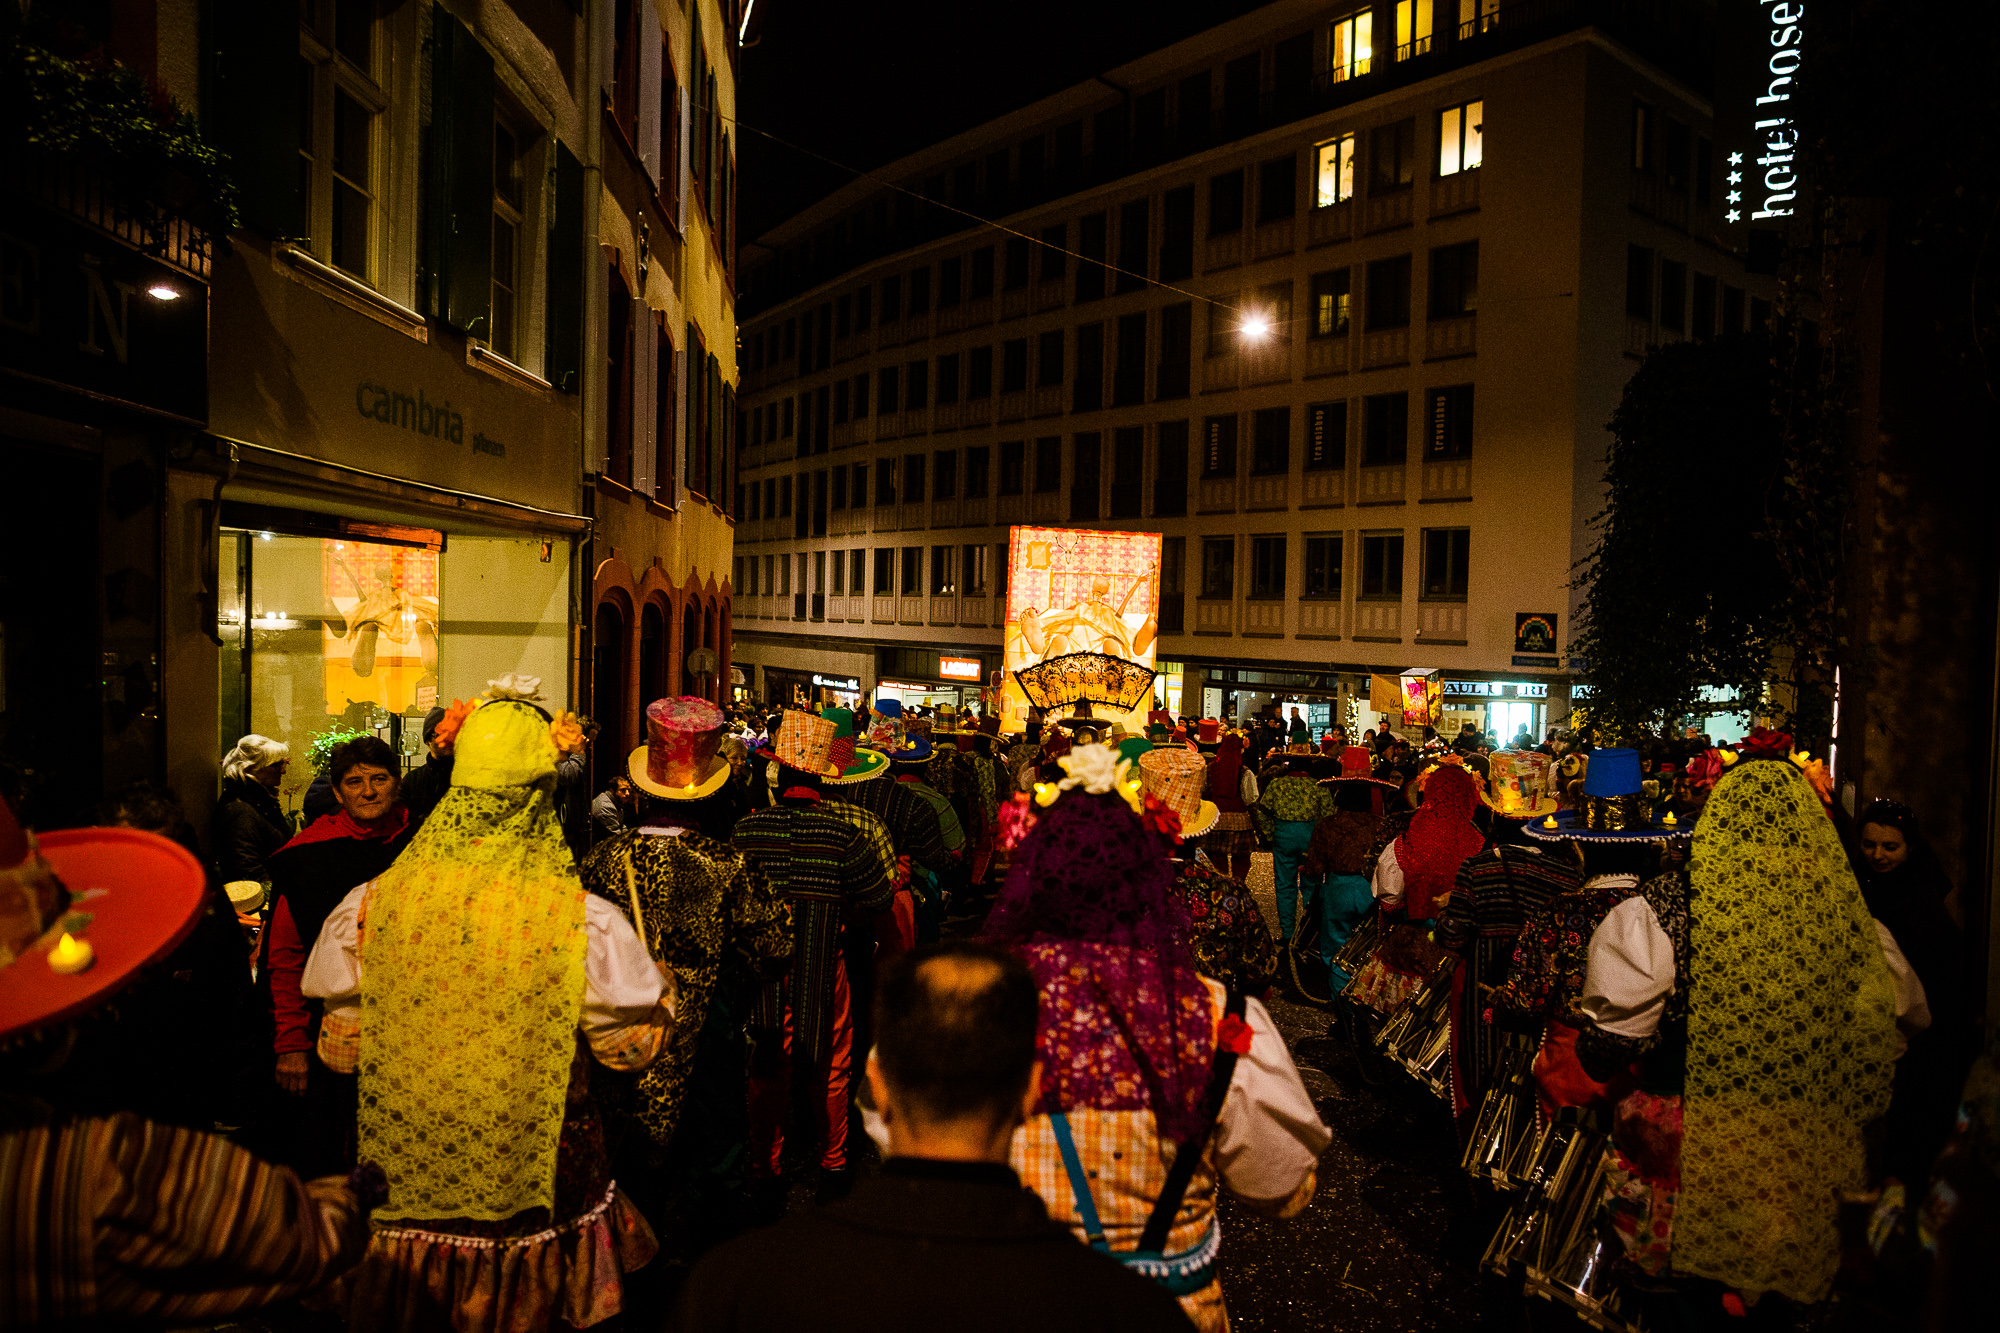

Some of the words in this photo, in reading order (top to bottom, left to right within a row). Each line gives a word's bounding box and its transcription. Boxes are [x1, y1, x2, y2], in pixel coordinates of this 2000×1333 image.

[1751, 118, 1799, 221] hotel
[356, 381, 464, 445] cambria
[1313, 410, 1325, 461] travelshop
[1433, 395, 1447, 452] travelshop
[1209, 423, 1220, 470] travelshop
[1442, 682, 1481, 694] AUL
